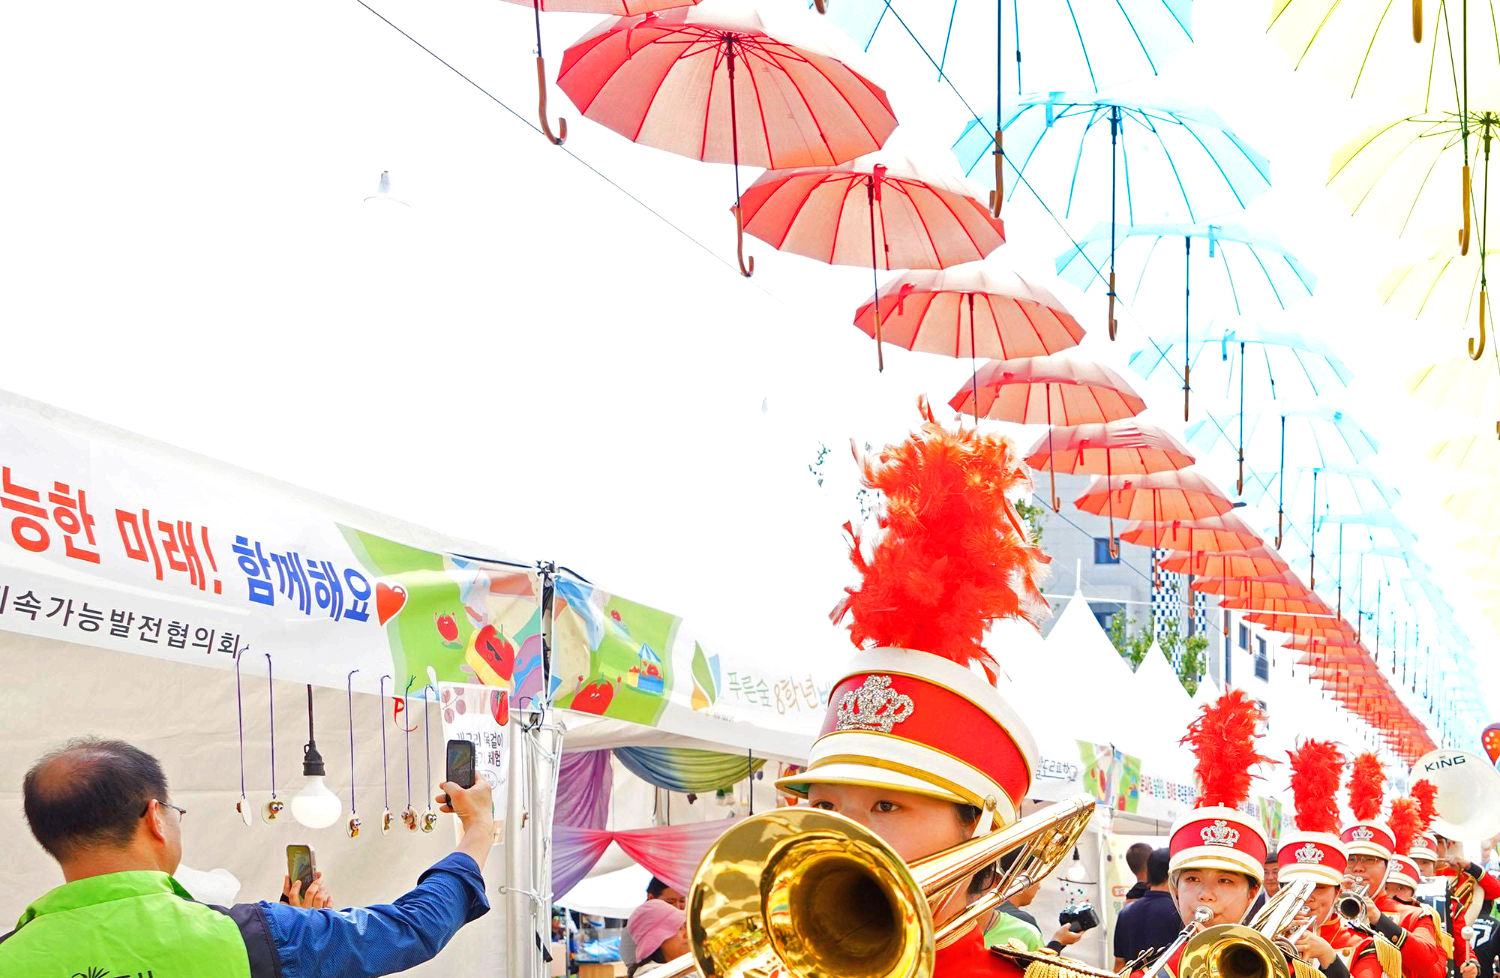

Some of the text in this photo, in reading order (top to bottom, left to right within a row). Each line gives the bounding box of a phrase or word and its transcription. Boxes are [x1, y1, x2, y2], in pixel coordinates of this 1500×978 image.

[0, 466, 372, 623] 능한 미래! 함께해요
[727, 671, 772, 708] 푸른숲
[1424, 755, 1466, 772] KING
